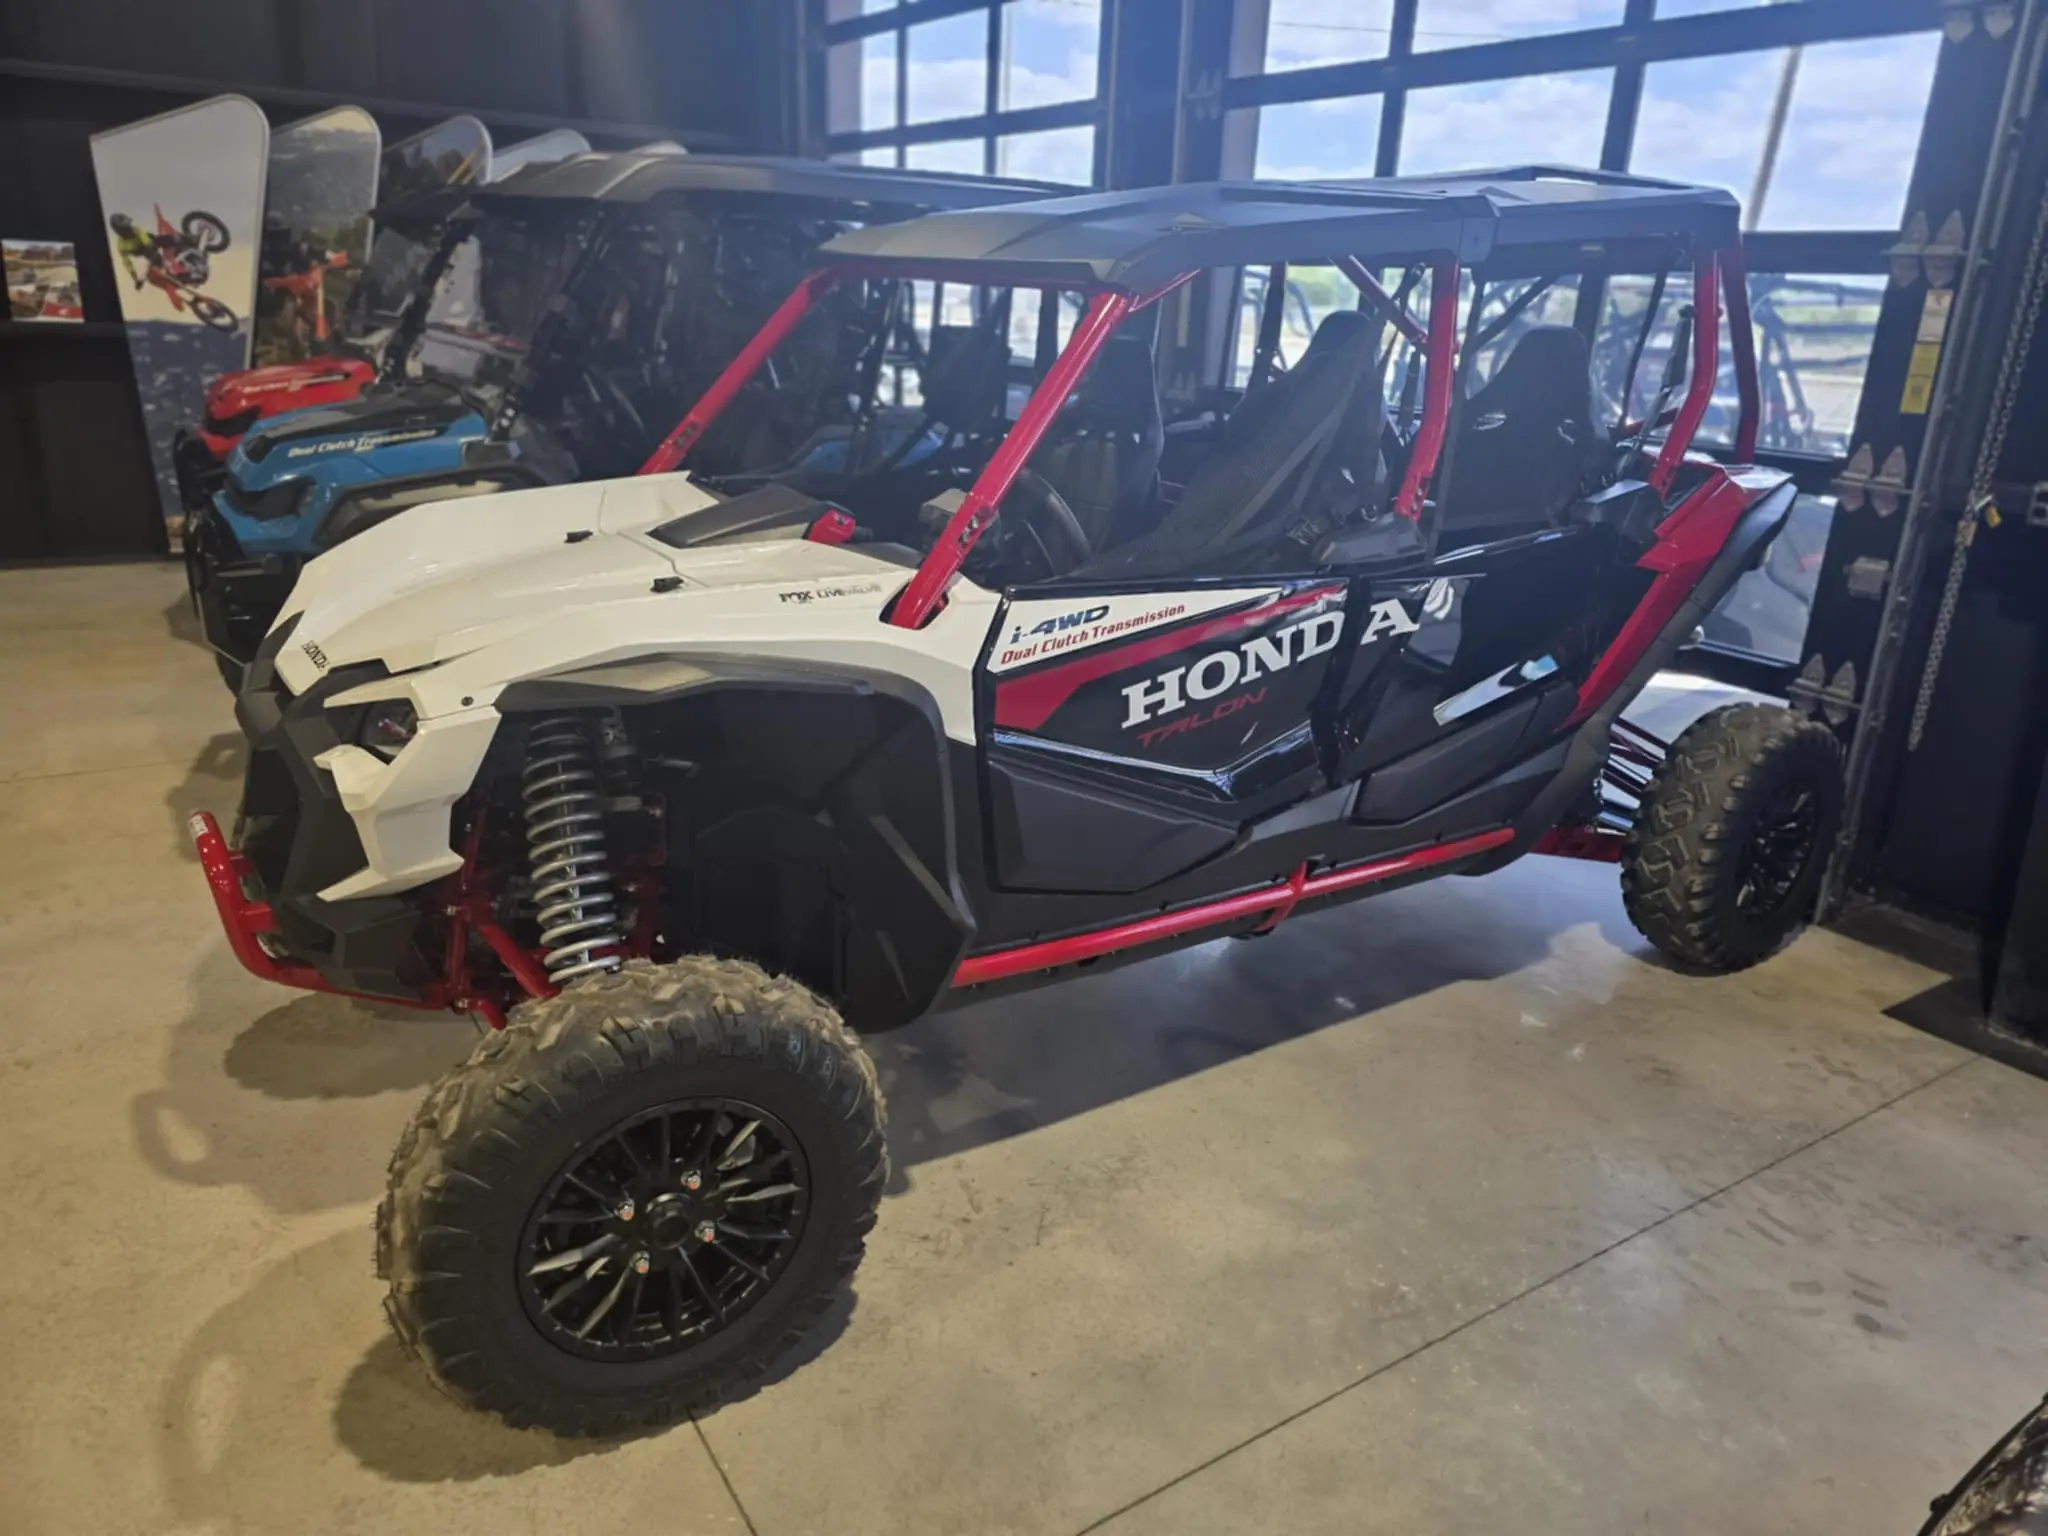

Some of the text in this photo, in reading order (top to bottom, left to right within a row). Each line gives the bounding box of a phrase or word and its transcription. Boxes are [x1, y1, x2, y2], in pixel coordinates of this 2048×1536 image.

[317, 439, 355, 453] Clutch
[1001, 604, 1186, 665] Dual Clutch Transmission
[1010, 605, 1109, 644] i-4WD
[1121, 598, 1420, 729] HONDA
[1137, 688, 1267, 747] TALON
